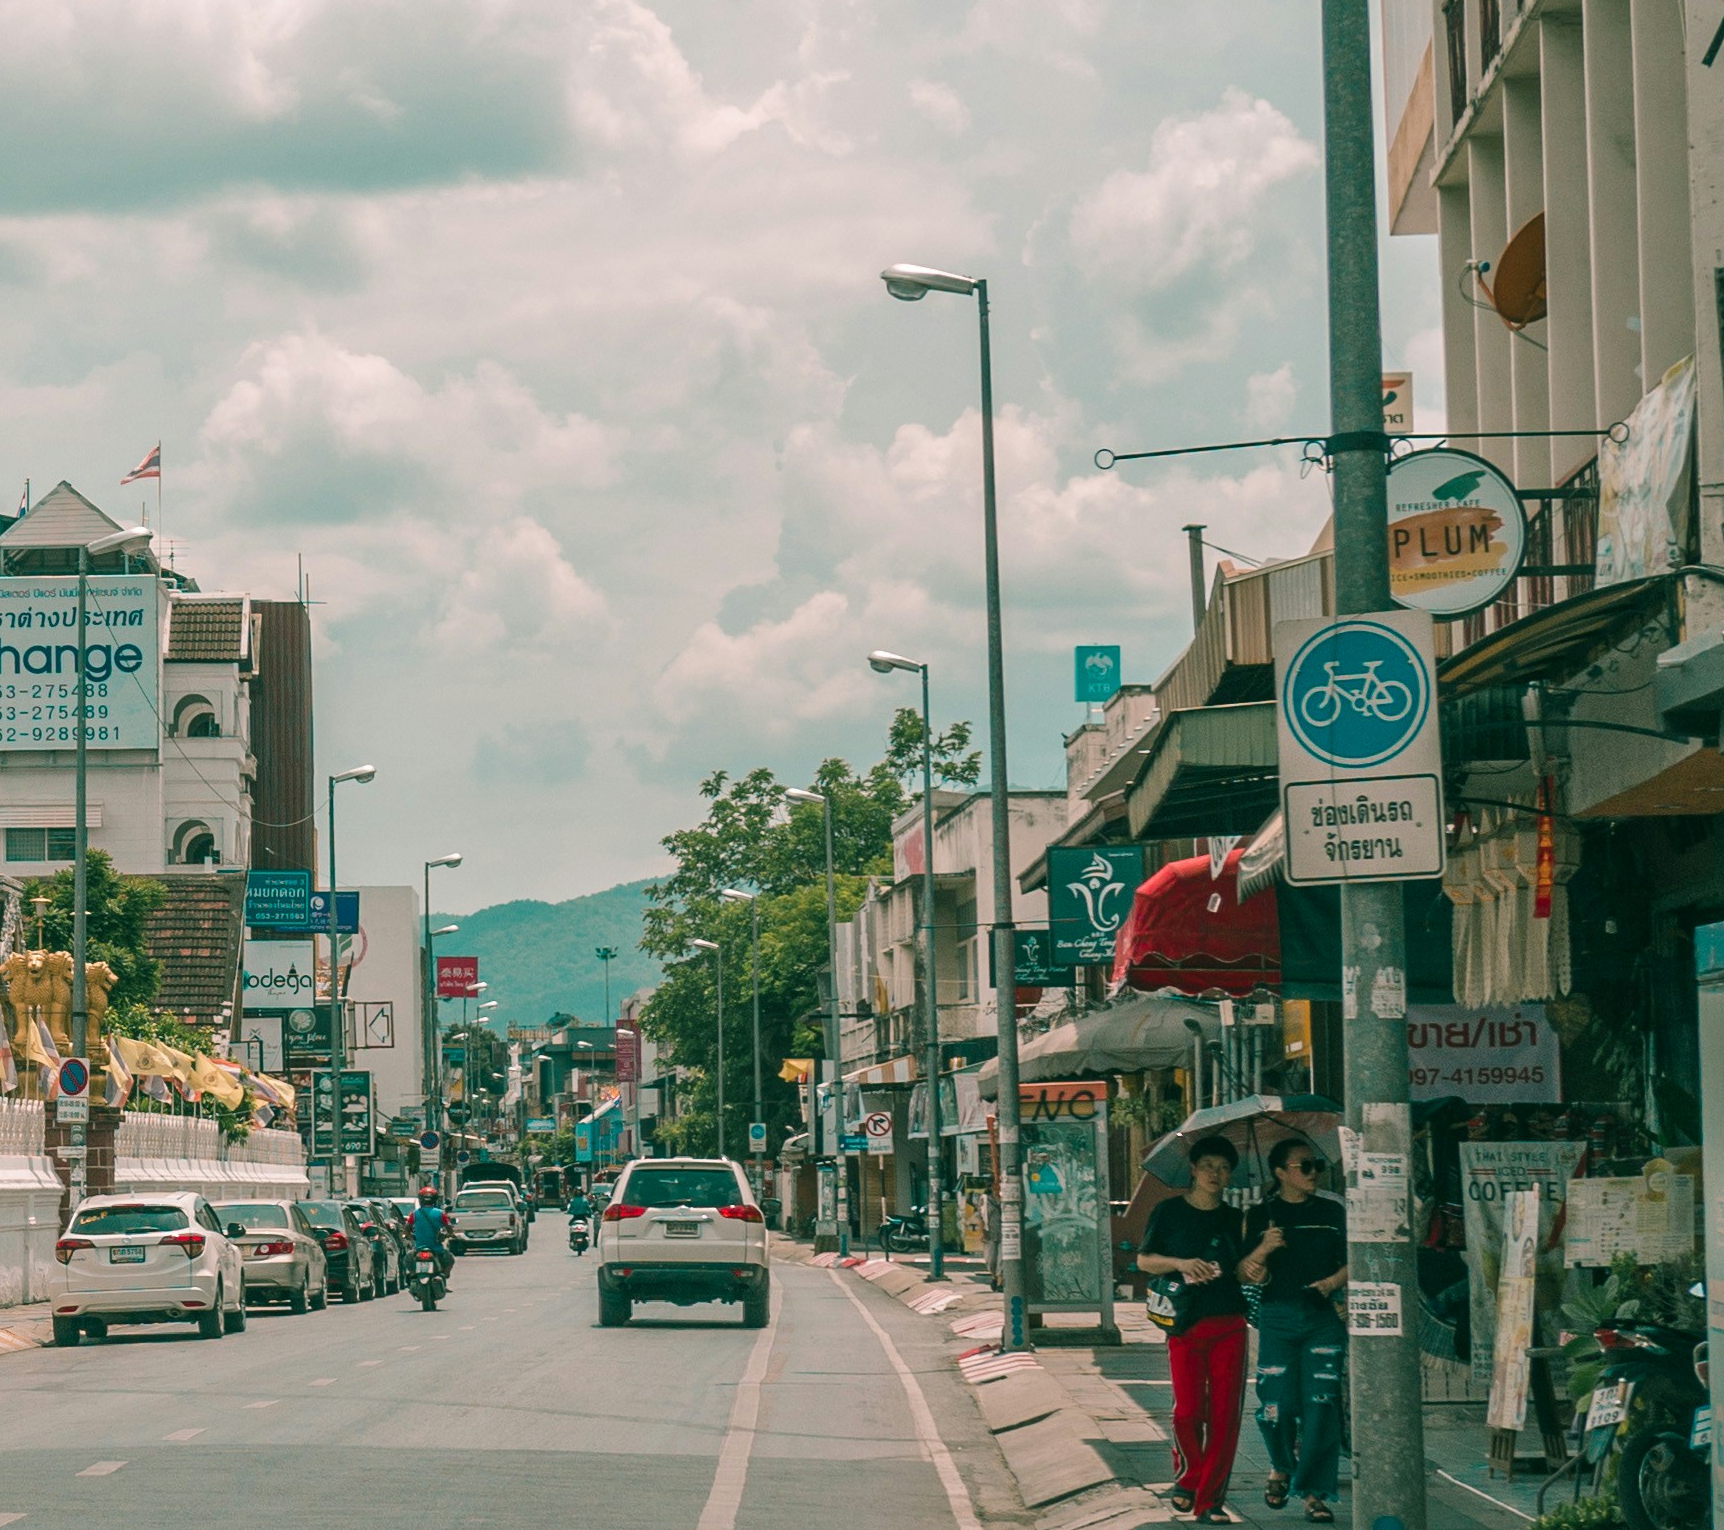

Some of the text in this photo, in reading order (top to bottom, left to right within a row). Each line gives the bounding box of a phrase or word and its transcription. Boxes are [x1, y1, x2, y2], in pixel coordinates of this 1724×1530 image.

[1456, 499, 1481, 509] CAFE
[1393, 524, 1491, 558] PLUM
[1310, 795, 1413, 827] ช่องเดินรถ
[1324, 832, 1403, 862] จักรยาน
[1408, 1012, 1538, 1049] ขาย/เช่า
[1409, 1066, 1544, 1086] 97-4159945
